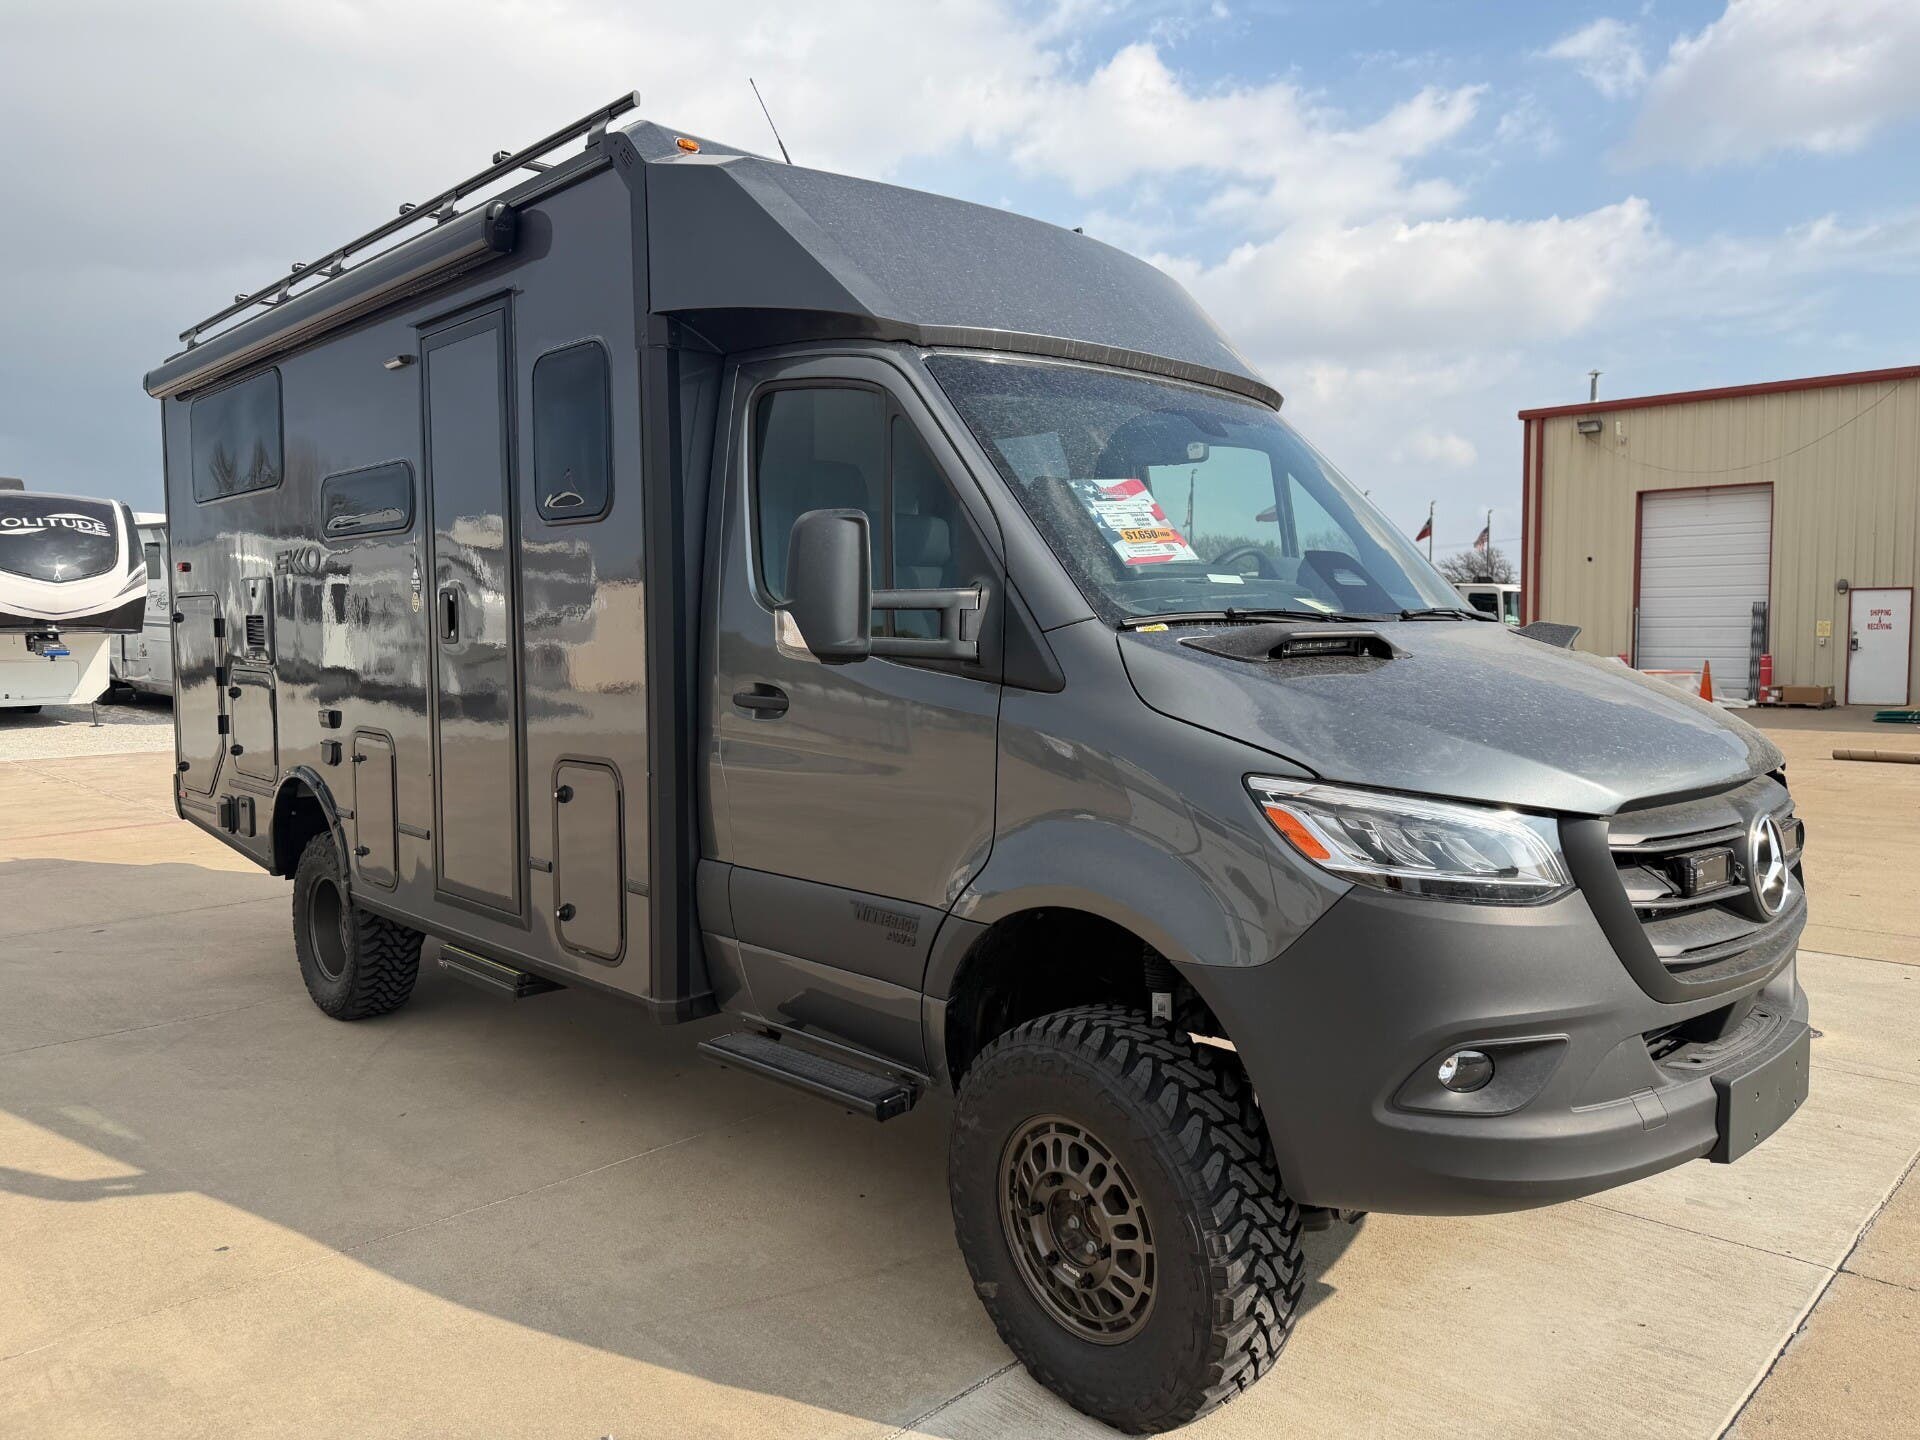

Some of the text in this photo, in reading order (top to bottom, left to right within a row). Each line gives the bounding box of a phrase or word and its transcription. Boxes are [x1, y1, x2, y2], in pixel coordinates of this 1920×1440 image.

[0, 517, 108, 533] OLITUDE
[275, 546, 321, 575] EKKO
[1870, 609, 1892, 617] SHIPPING
[1867, 623, 1892, 631] RECEIVING
